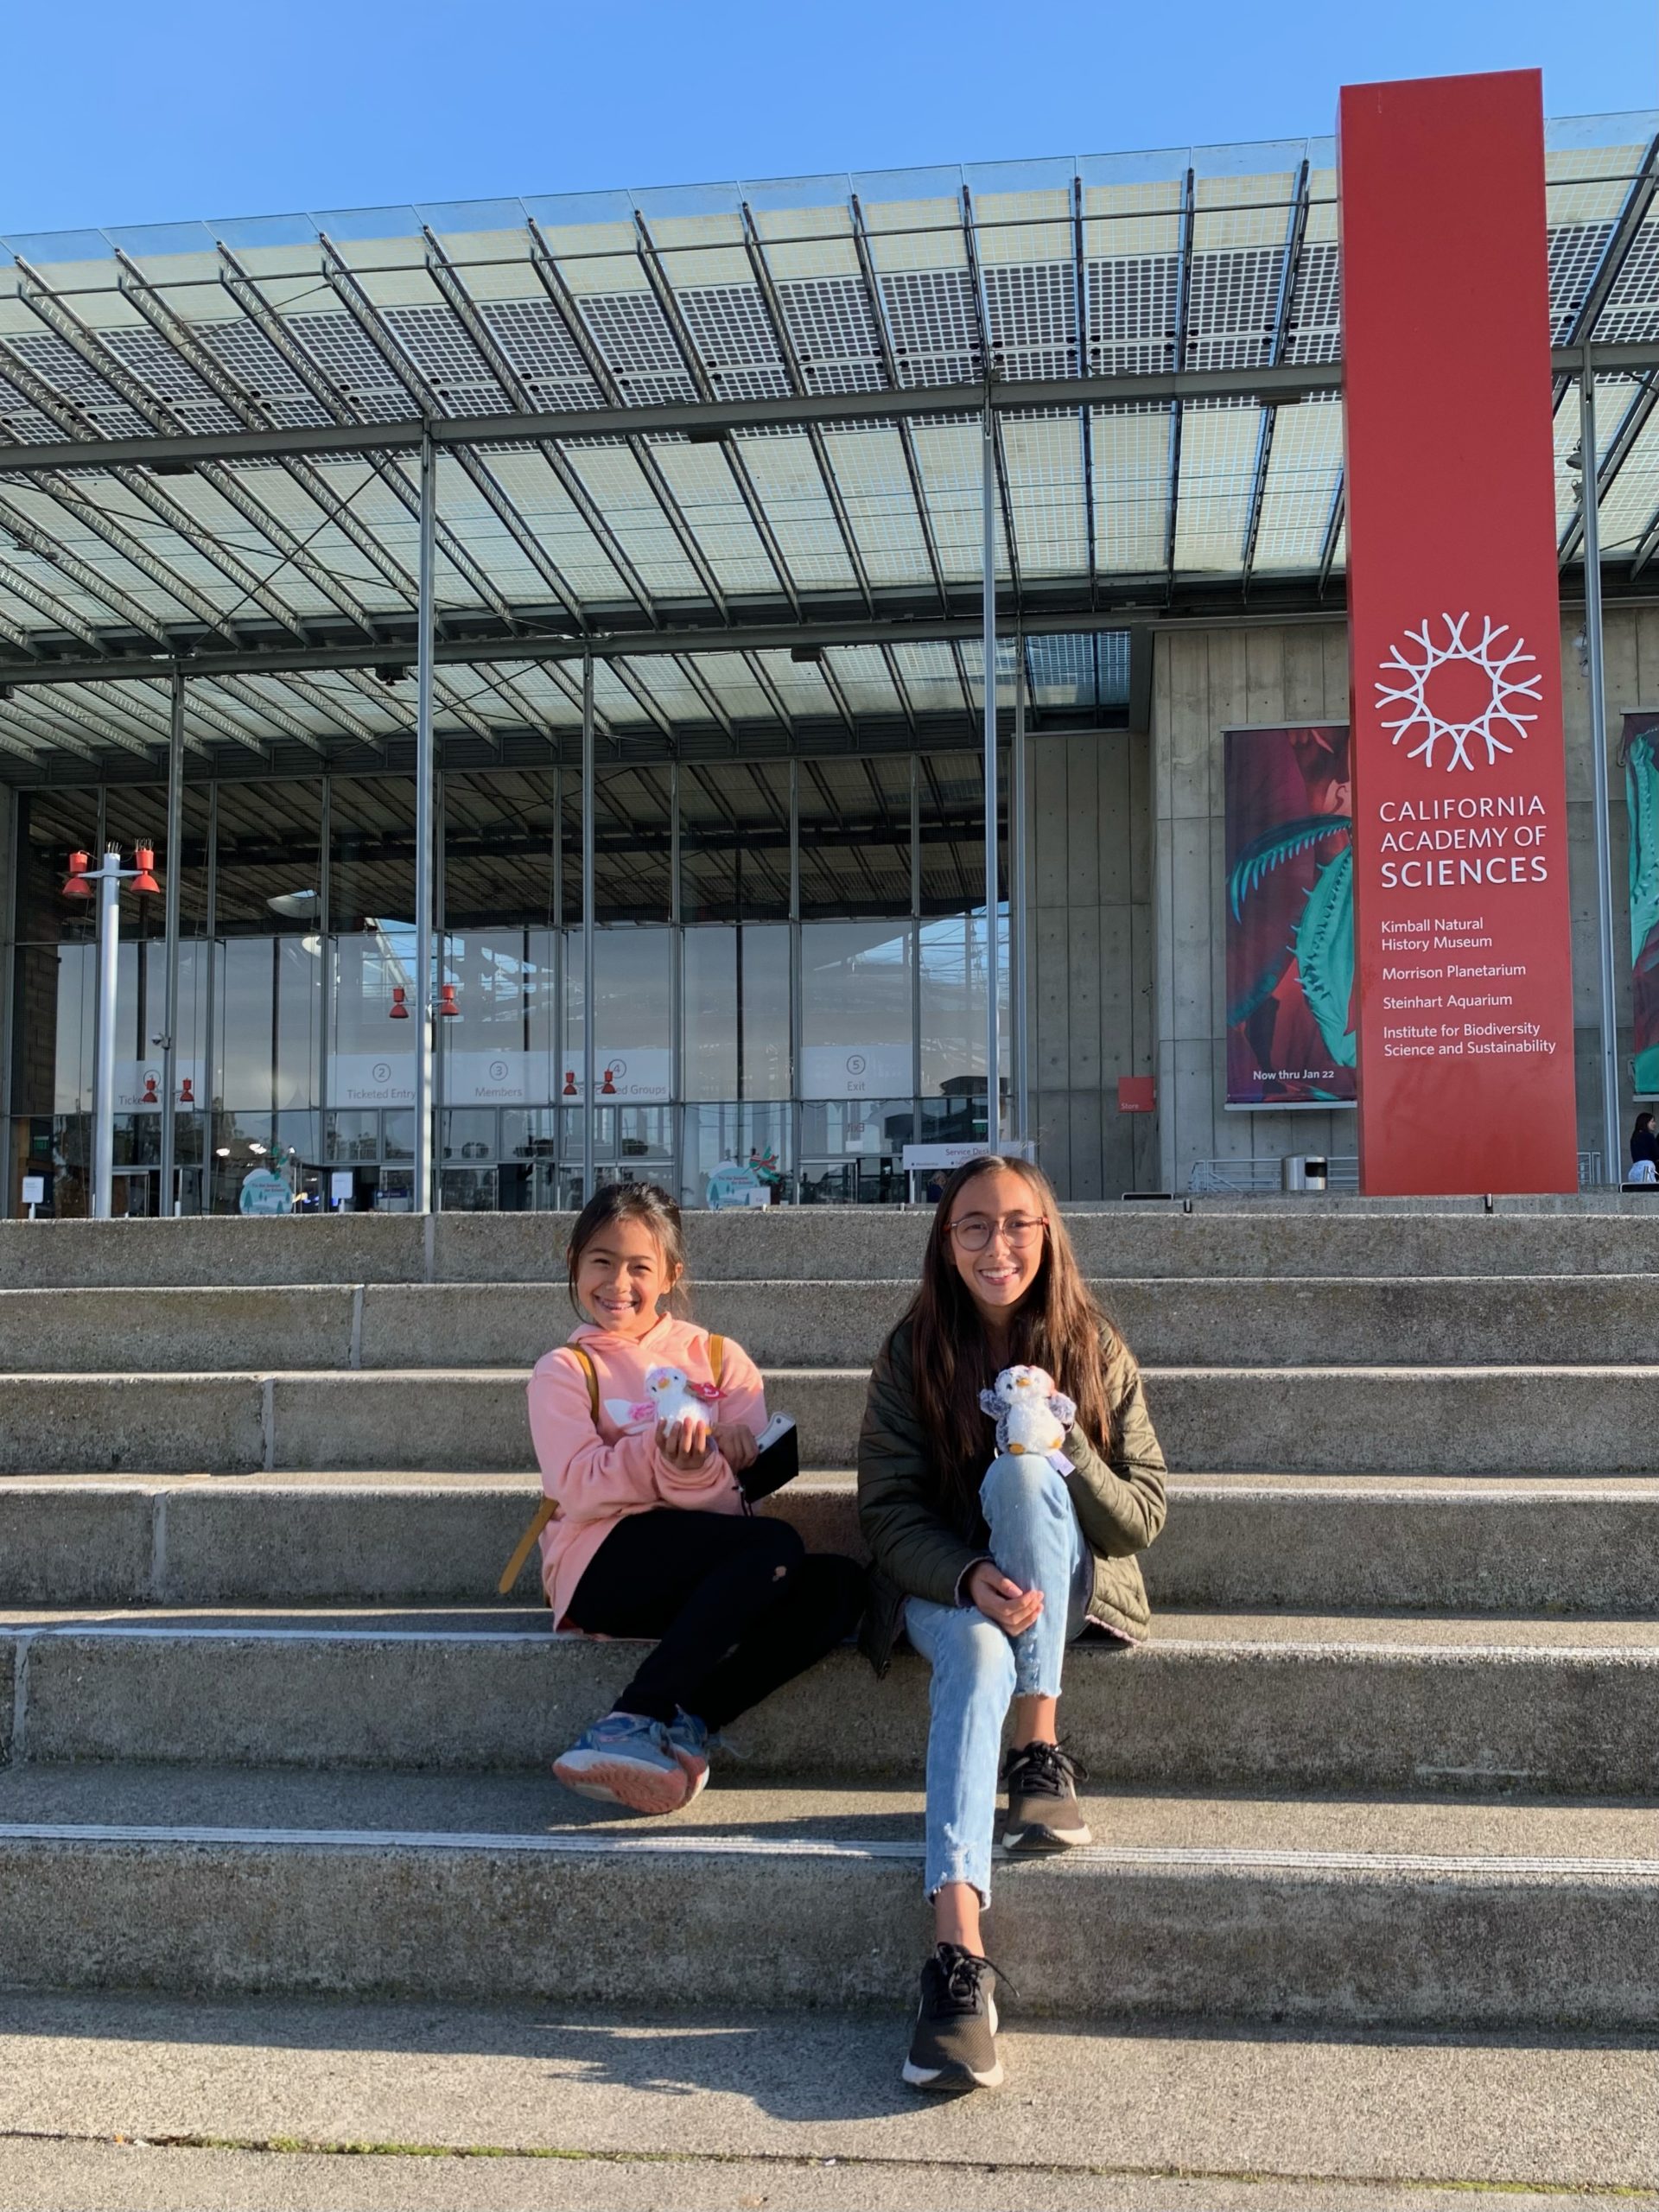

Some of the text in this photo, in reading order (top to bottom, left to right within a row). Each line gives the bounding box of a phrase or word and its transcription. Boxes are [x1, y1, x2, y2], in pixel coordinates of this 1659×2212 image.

[1379, 795, 1547, 823] CALIFORNIA
[1380, 825, 1548, 854] ACADEMY OF
[1381, 855, 1548, 888] SCIENCES
[1381, 916, 1484, 933] Kimball Natural
[1382, 936, 1492, 952] History Museum
[1382, 963, 1527, 981] Morrison Planetarium
[1382, 993, 1513, 1010] Steinhart Aquarium
[1383, 1021, 1541, 1039] Institute for Biodiversity
[1384, 1039, 1556, 1057] Science and Sustainability
[1253, 1071, 1277, 1080] Now
[1279, 1070, 1300, 1079] thru
[1303, 1070, 1320, 1079] Jan
[347, 1088, 416, 1101] Ticketed Entry
[475, 1087, 523, 1097] Members
[630, 1084, 666, 1096] Groups
[848, 1081, 865, 1091] Exit
